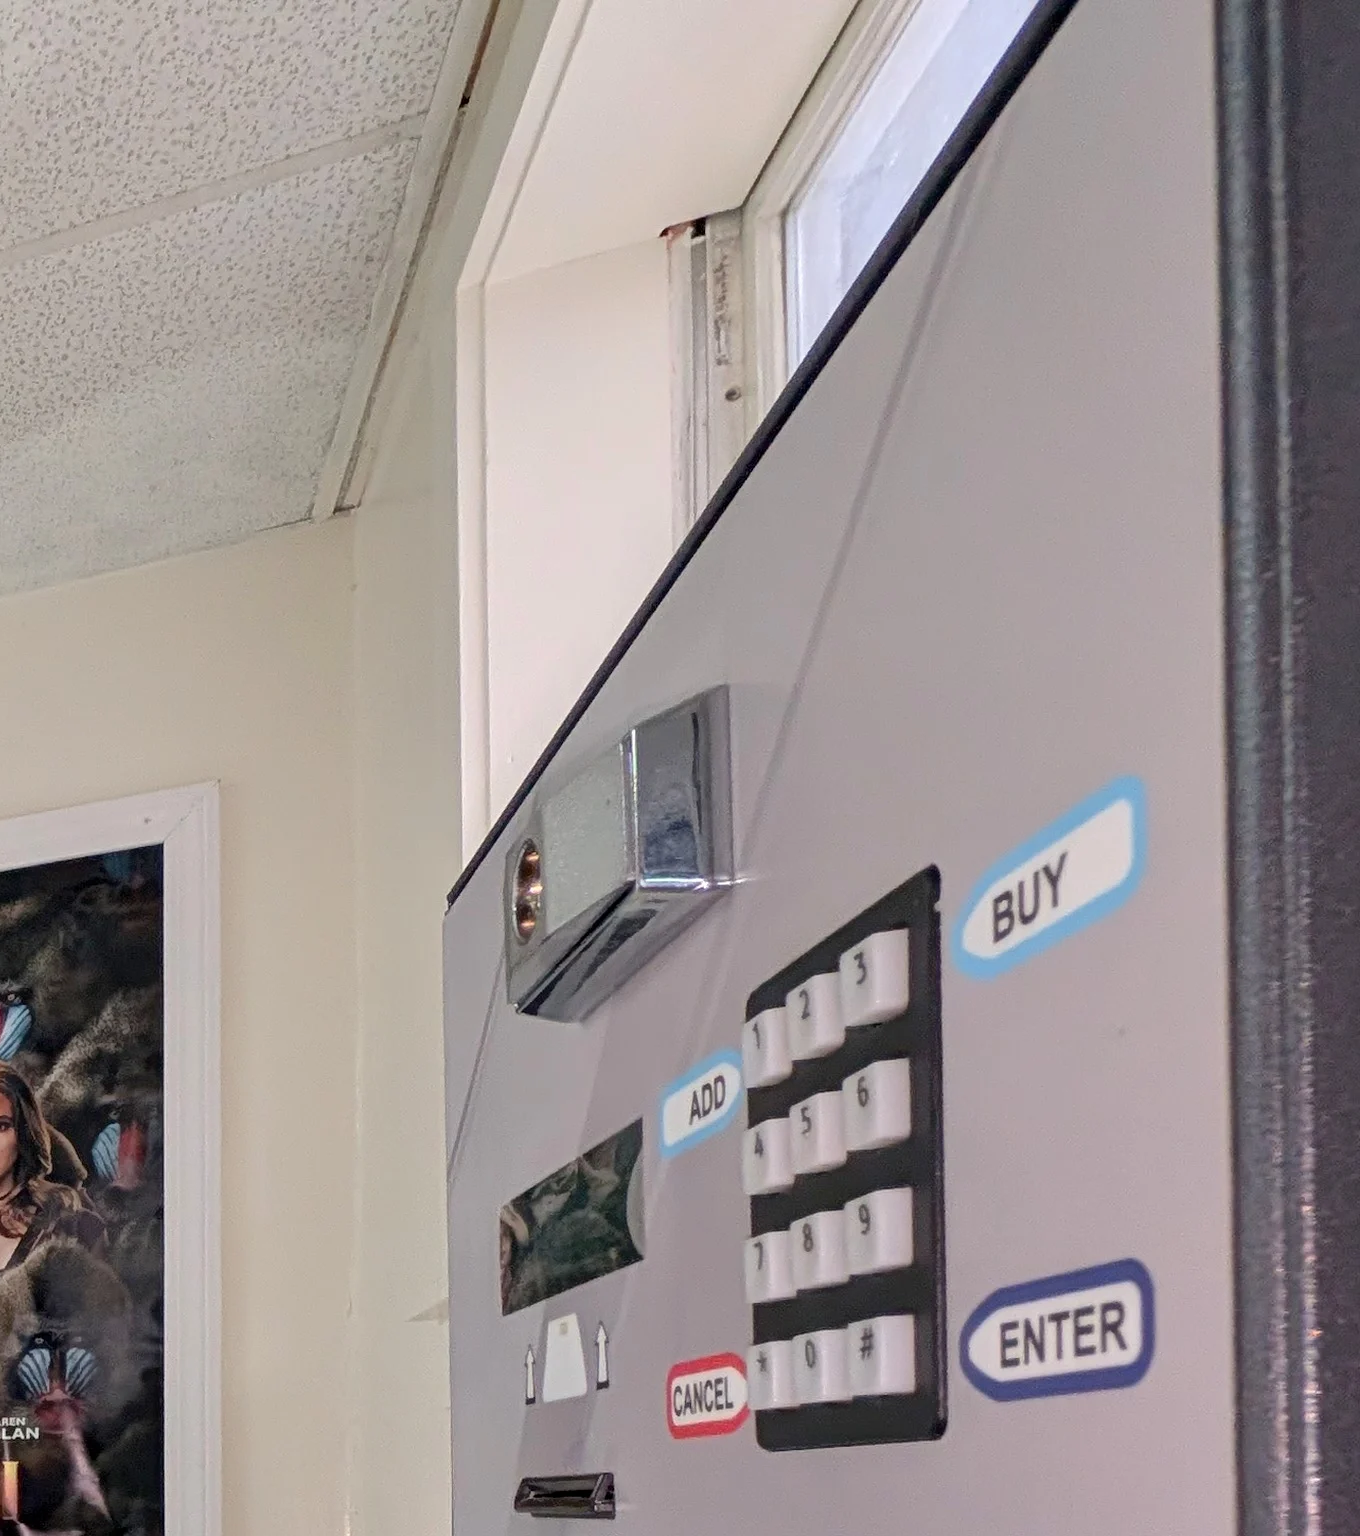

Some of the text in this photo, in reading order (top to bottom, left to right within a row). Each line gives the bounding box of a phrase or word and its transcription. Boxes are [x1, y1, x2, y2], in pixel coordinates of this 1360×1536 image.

[992, 851, 1068, 944] BUY
[853, 951, 867, 985] 3
[799, 989, 810, 1020] 2
[752, 1022, 761, 1050] 1
[688, 1074, 726, 1126] ADD
[857, 1075, 870, 1108] 6
[801, 1106, 812, 1135] 5
[754, 1132, 764, 1158] 4
[858, 1203, 871, 1235] 9
[802, 1223, 814, 1253] 8
[754, 1241, 764, 1271] 7
[999, 1300, 1128, 1369] ENTER
[805, 1339, 816, 1369] 0
[672, 1376, 735, 1418] CANCEL
